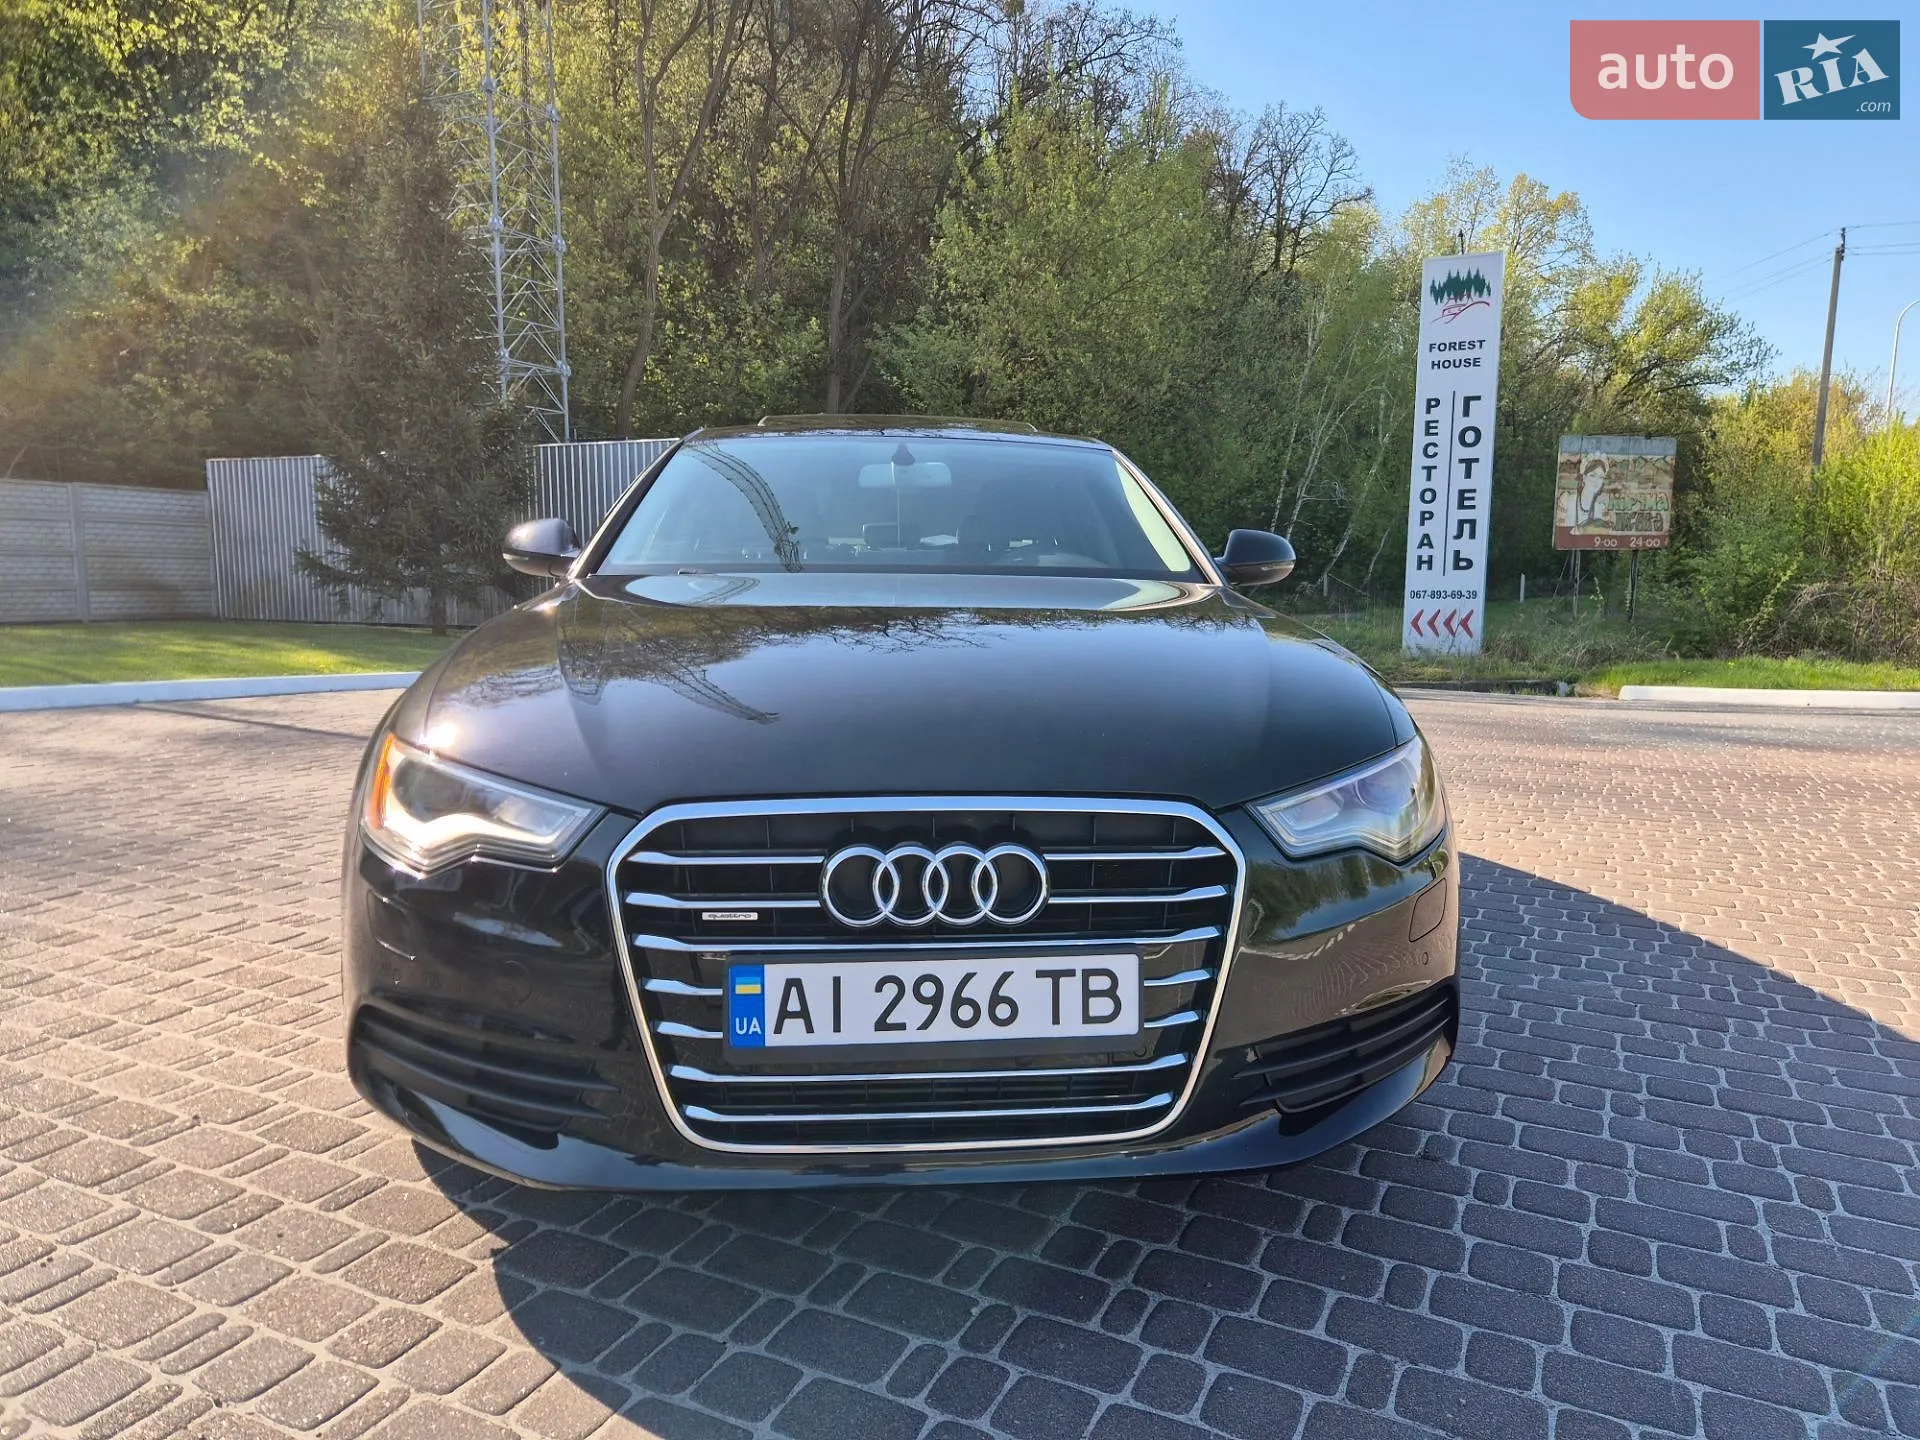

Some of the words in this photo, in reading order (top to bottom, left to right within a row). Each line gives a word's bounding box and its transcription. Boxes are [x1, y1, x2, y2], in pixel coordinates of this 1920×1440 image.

[1429, 339, 1486, 353] FOREST
[1431, 357, 1481, 370] HOUSE
[1416, 397, 1441, 571] РЕСТОРАН
[1452, 395, 1482, 571] ГОТЕЛЬ
[1409, 589, 1478, 600] 067-893-69-39
[773, 975, 842, 1035] AI
[873, 970, 1020, 1032] 2966
[1035, 967, 1123, 1026] TB
[735, 1016, 762, 1035] UA
